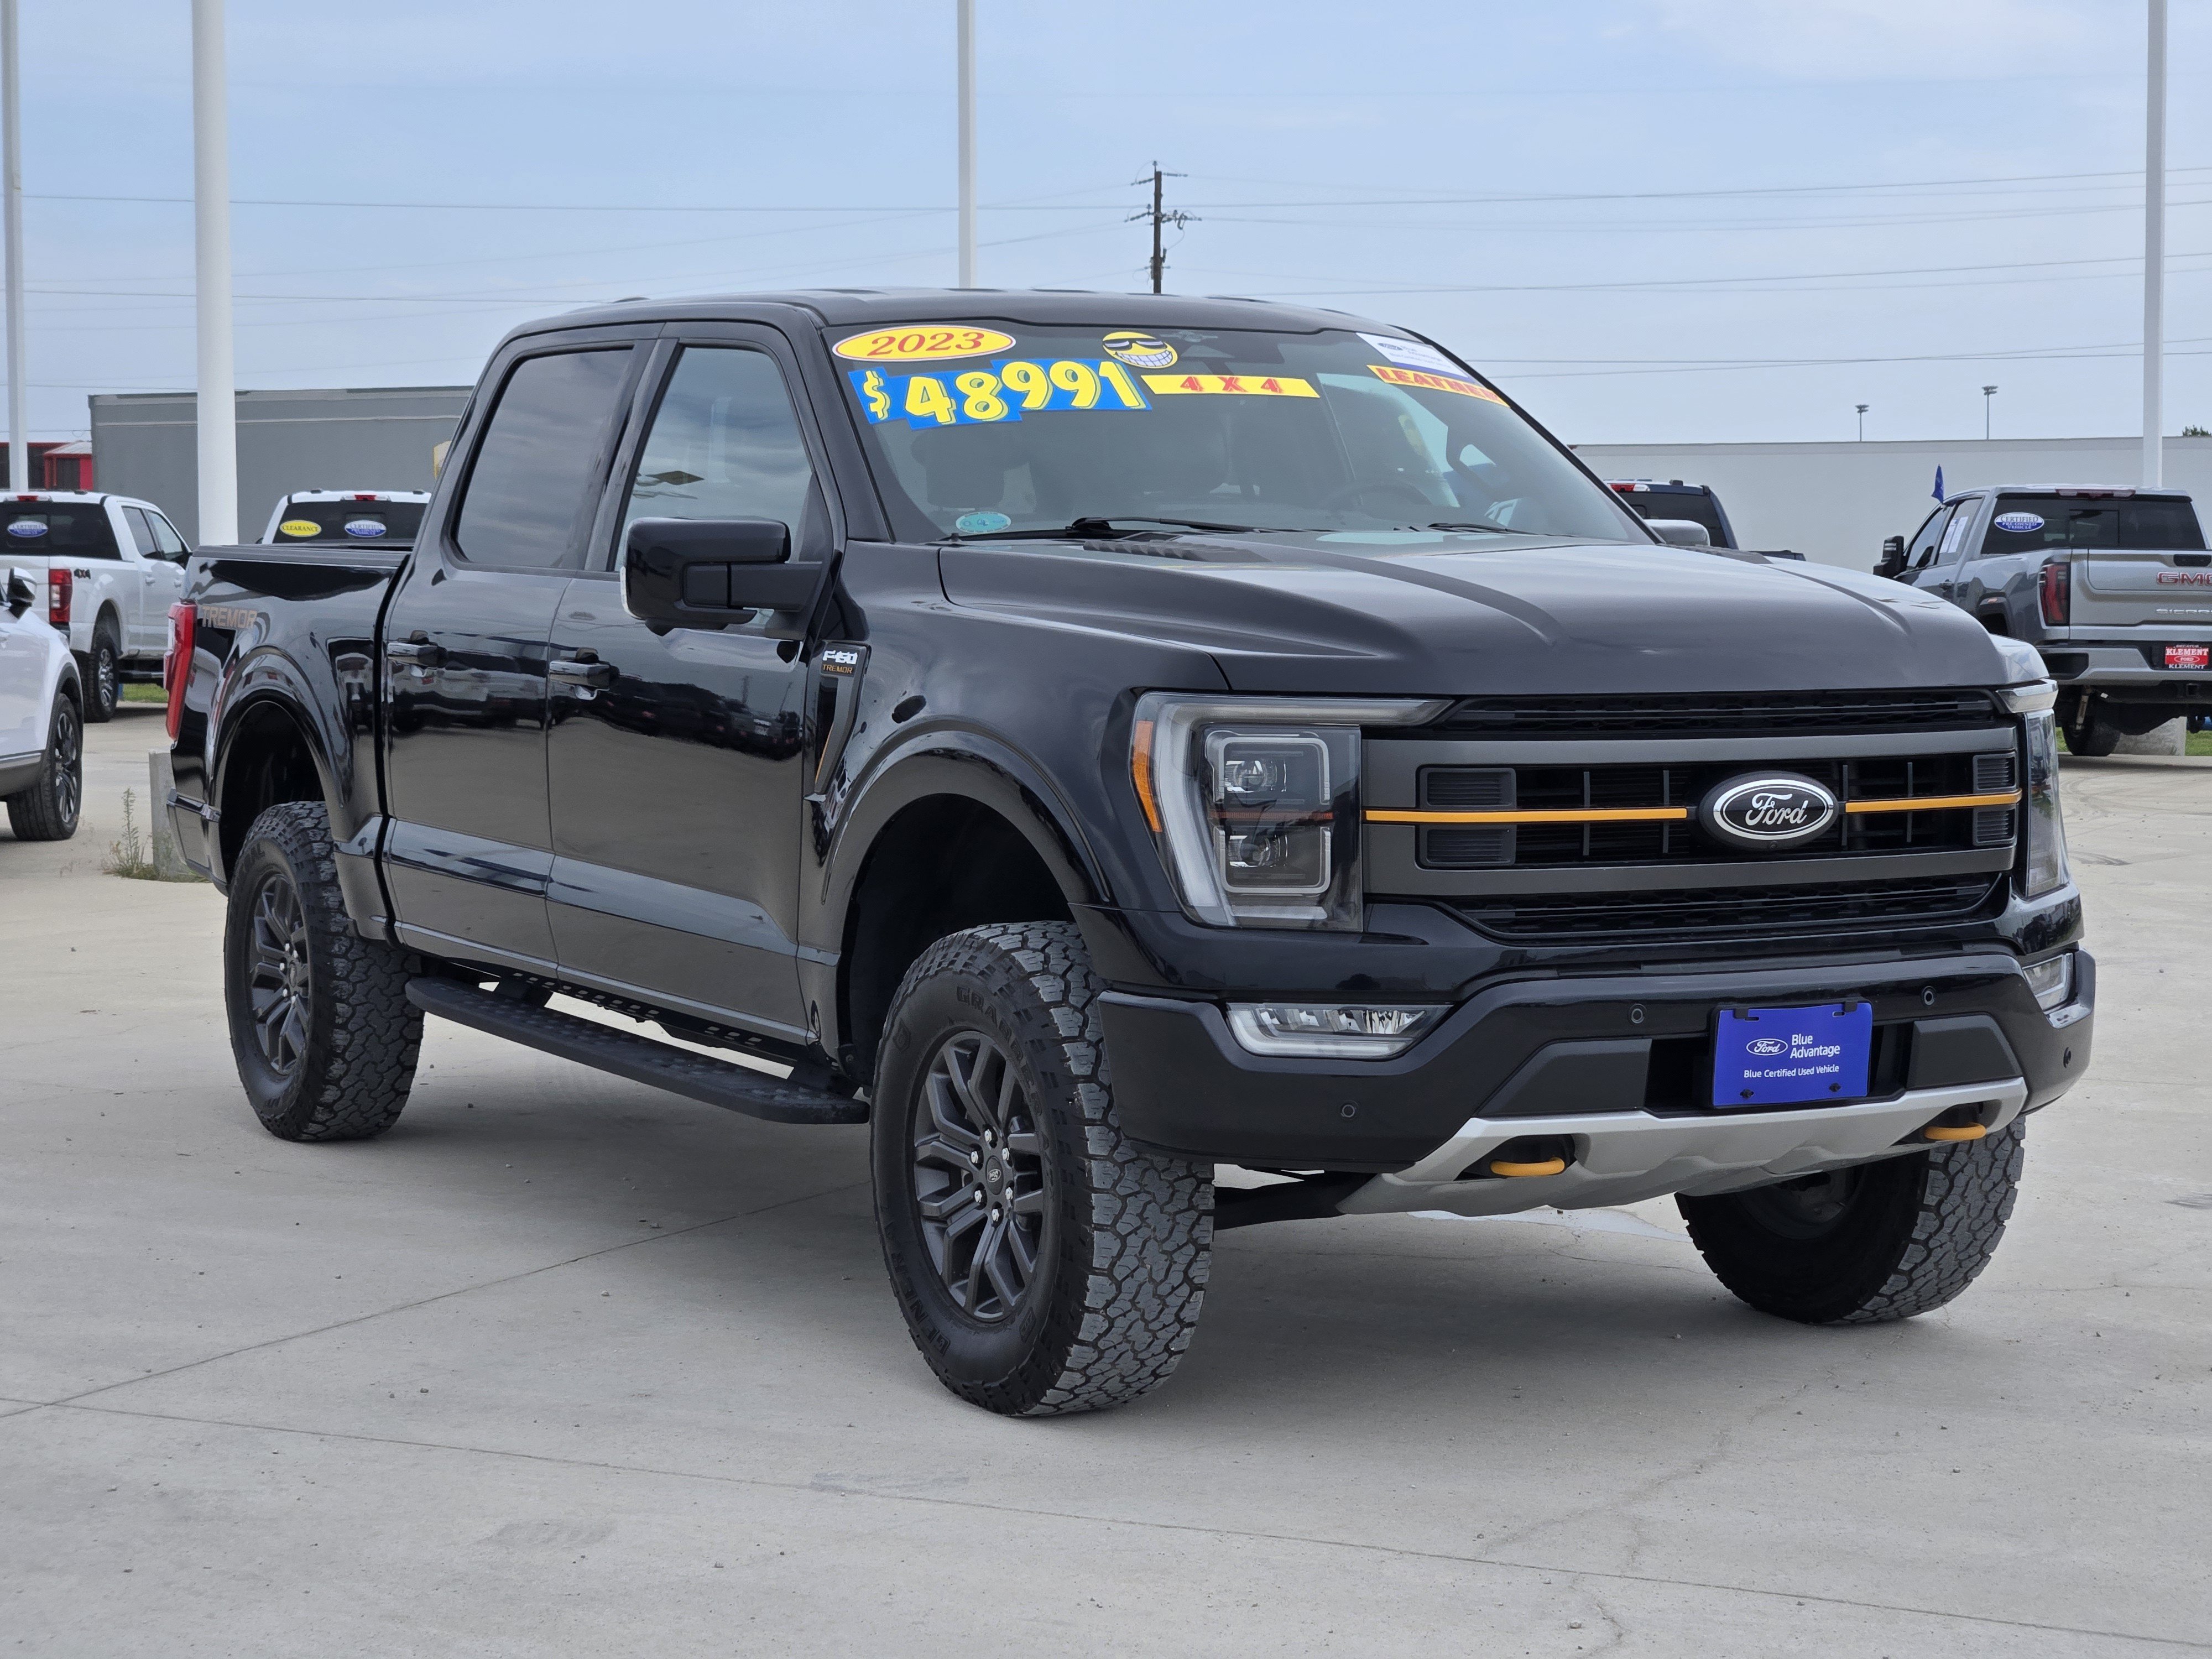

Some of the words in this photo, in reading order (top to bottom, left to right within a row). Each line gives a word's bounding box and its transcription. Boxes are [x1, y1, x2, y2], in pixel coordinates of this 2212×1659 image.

[866, 332, 985, 357] 2023
[1375, 368, 1499, 401] LEATHER
[202, 606, 258, 628] TREMOR
[823, 664, 853, 674] TREMOR
[1745, 792, 1809, 826] Ford
[1754, 1041, 1781, 1052] Ford
[1791, 1034, 1813, 1046] Blue
[1790, 1045, 1840, 1059] Advantage
[1744, 1070, 1762, 1078] Blue
[1764, 1068, 1797, 1077] Certified
[1798, 1067, 1814, 1076] Used
[1816, 1064, 1840, 1074] Vehicle
